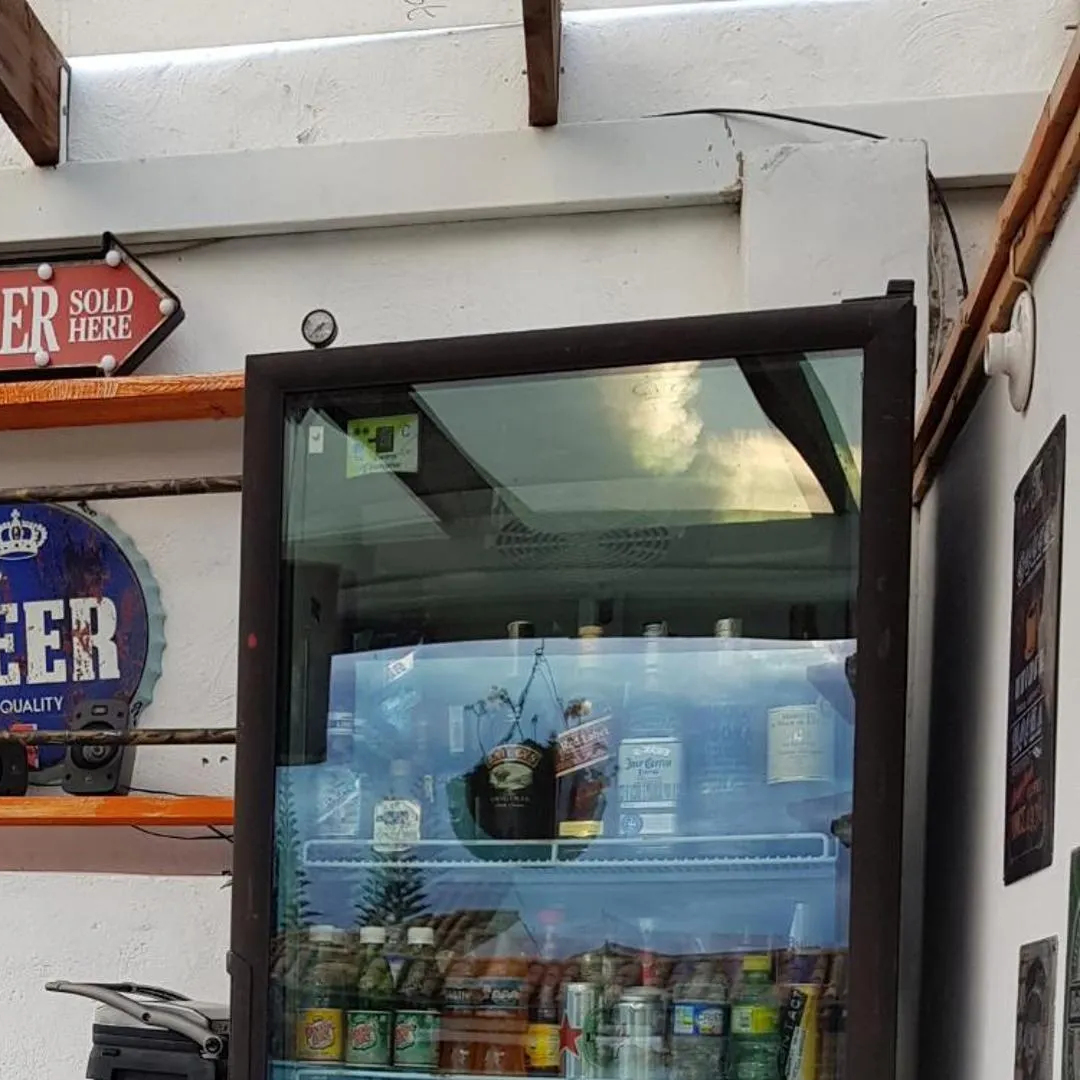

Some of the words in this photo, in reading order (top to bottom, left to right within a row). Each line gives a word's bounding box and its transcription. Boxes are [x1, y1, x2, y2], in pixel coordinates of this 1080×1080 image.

[69, 288, 134, 315] SOLD
[68, 315, 133, 343] HERE
[0, 696, 64, 714] QUALITY
